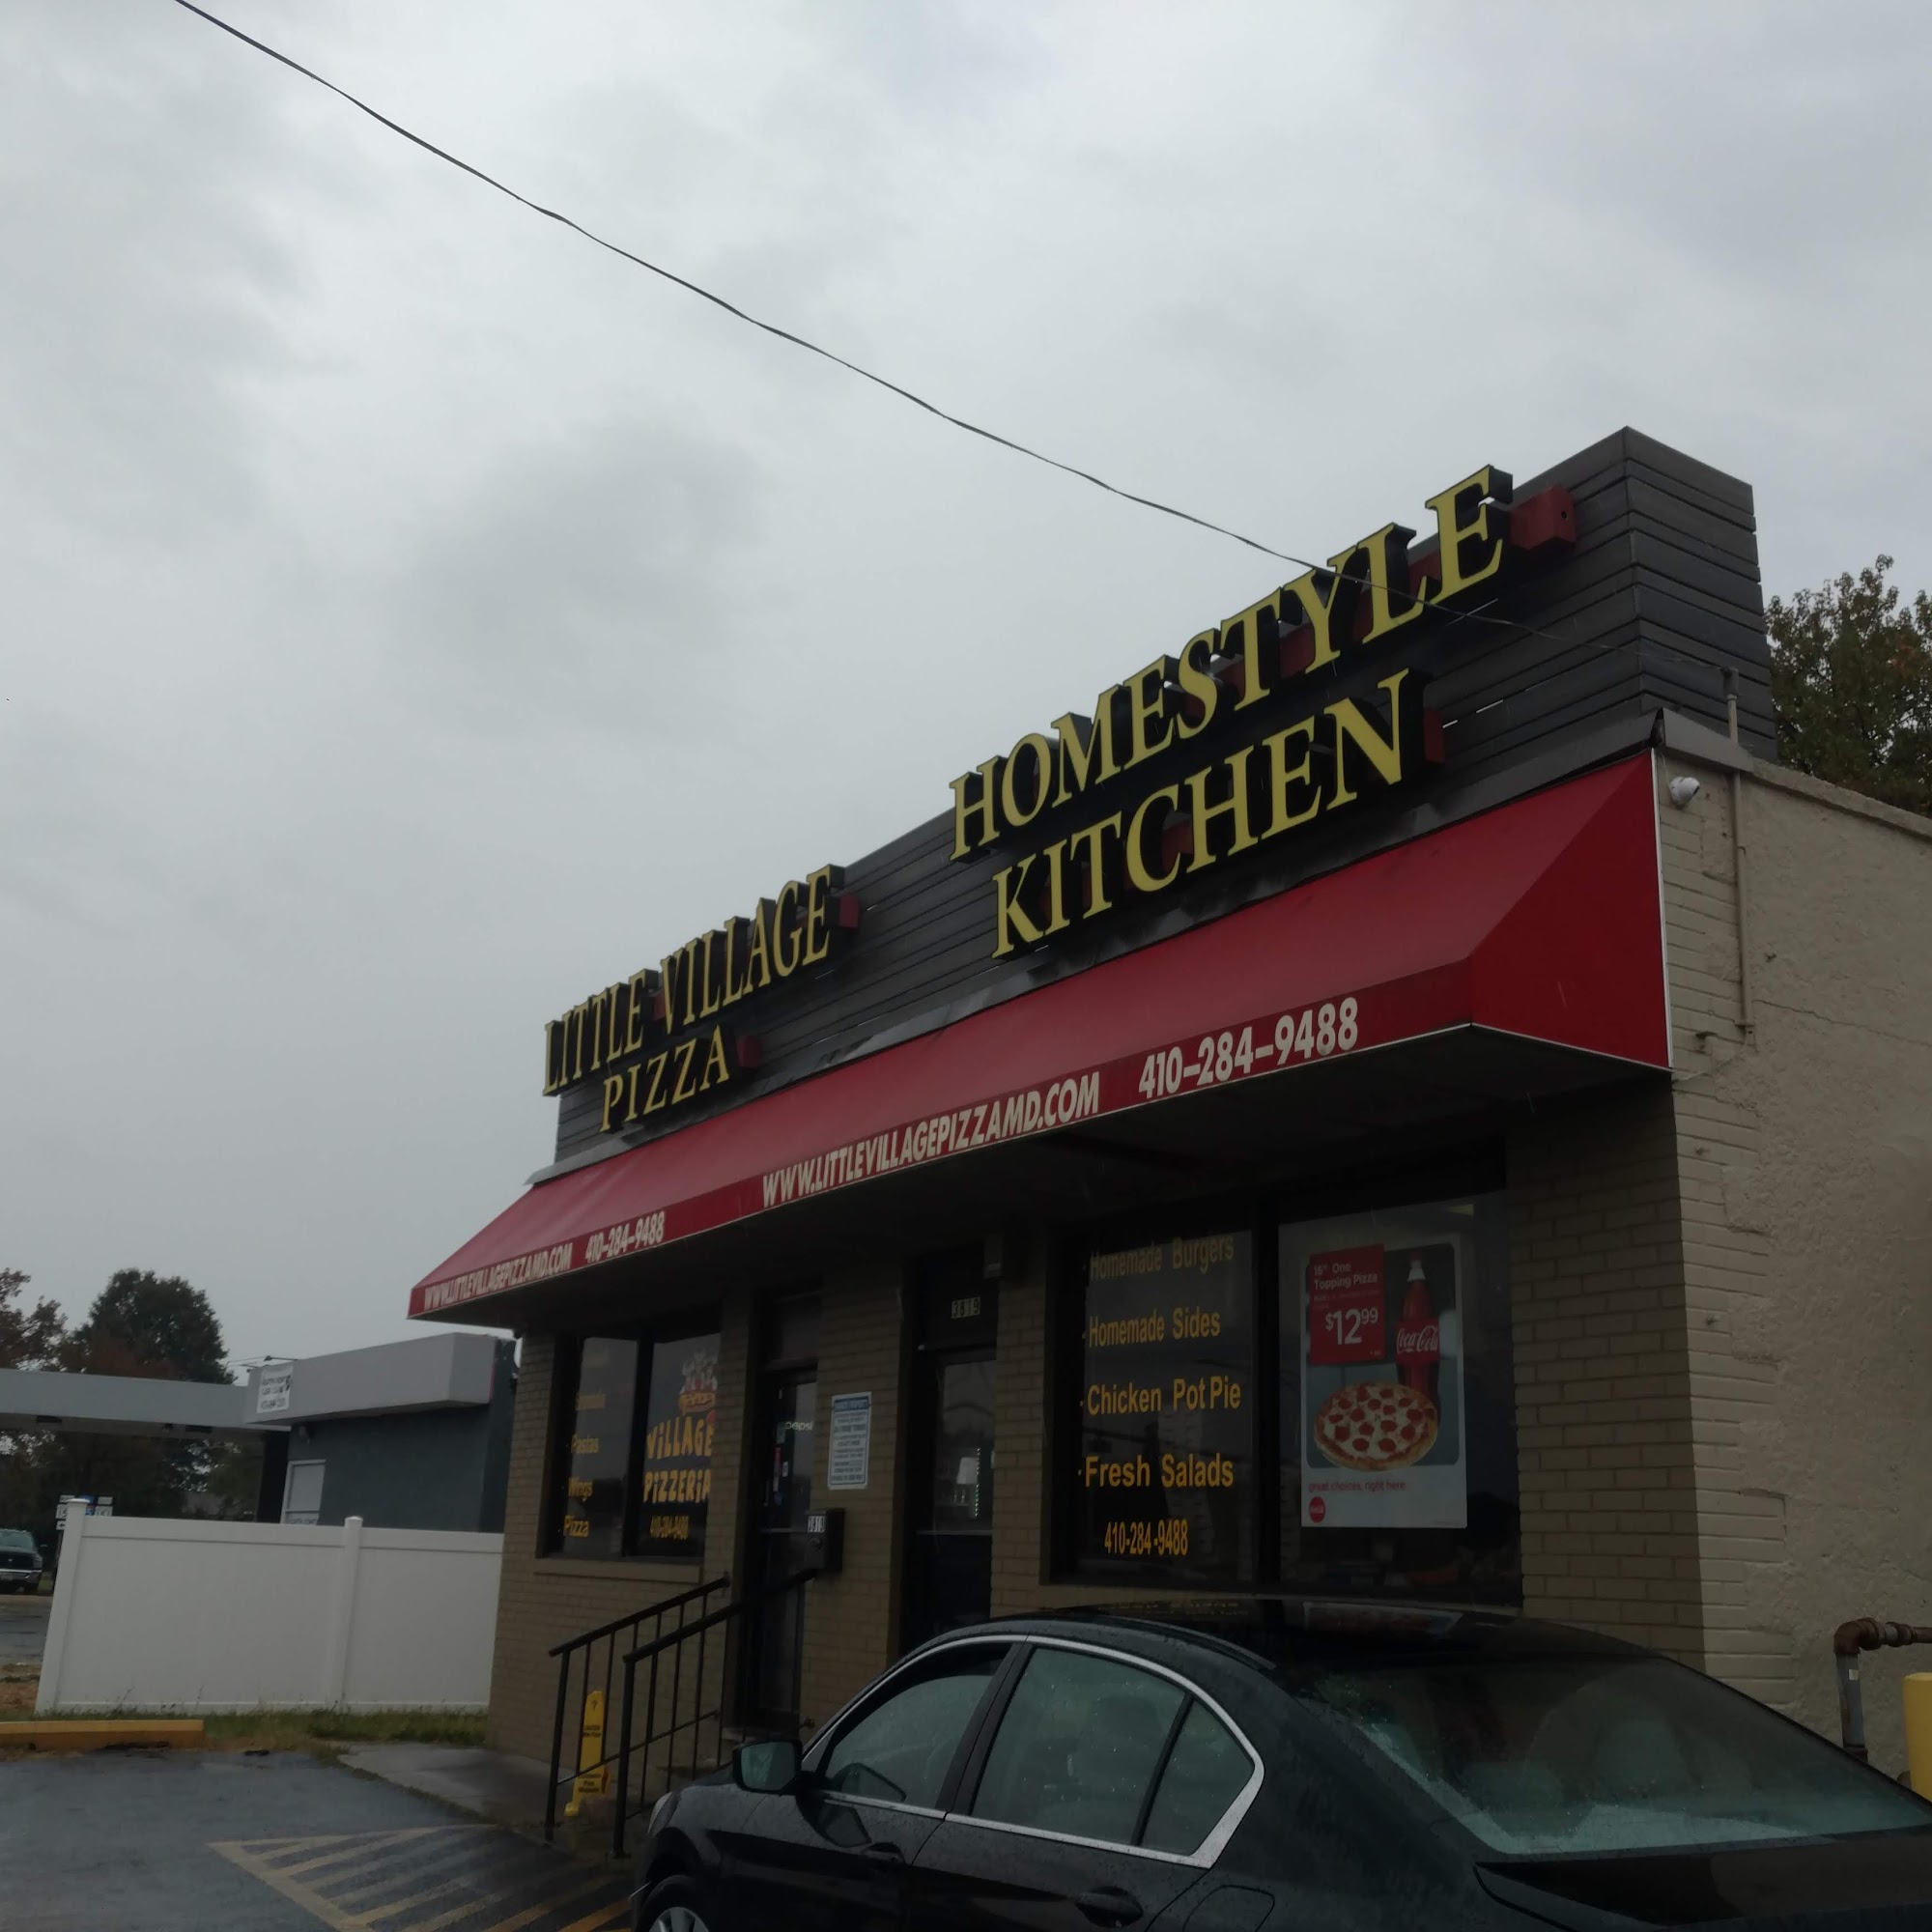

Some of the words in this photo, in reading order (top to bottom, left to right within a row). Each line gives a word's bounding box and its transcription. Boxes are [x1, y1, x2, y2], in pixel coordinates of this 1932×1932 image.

[950, 464, 1507, 862] HOMESTYLE
[991, 667, 1412, 959] KITCHEN
[543, 968, 648, 1096] LITTLE
[660, 863, 834, 1036] VILLAGE
[599, 1024, 730, 1133] PIZZA
[761, 1071, 1100, 1209] WWW.LITTLEVILLAGEPIZZAMD.COM
[1138, 997, 1359, 1100] 410-284-9488
[584, 1211, 666, 1264] 410-284-9488
[1172, 1235, 1235, 1275] Burgers
[1313, 1275, 1352, 1291] Topping
[1352, 1272, 1379, 1286] Pizza
[1332, 1262, 1352, 1274] One
[1089, 1308, 1165, 1348] Homemade
[1172, 1306, 1221, 1340] Sides
[1087, 1382, 1161, 1416] Chicken
[1173, 1378, 1206, 1411] Pot
[1209, 1376, 1241, 1409] Pie
[1084, 1454, 1151, 1488] Fresh
[1160, 1452, 1234, 1489] Salads
[1364, 1480, 1384, 1492] right
[562, 1515, 590, 1538] Pizza
[1104, 1518, 1189, 1557] 410-284-9488
